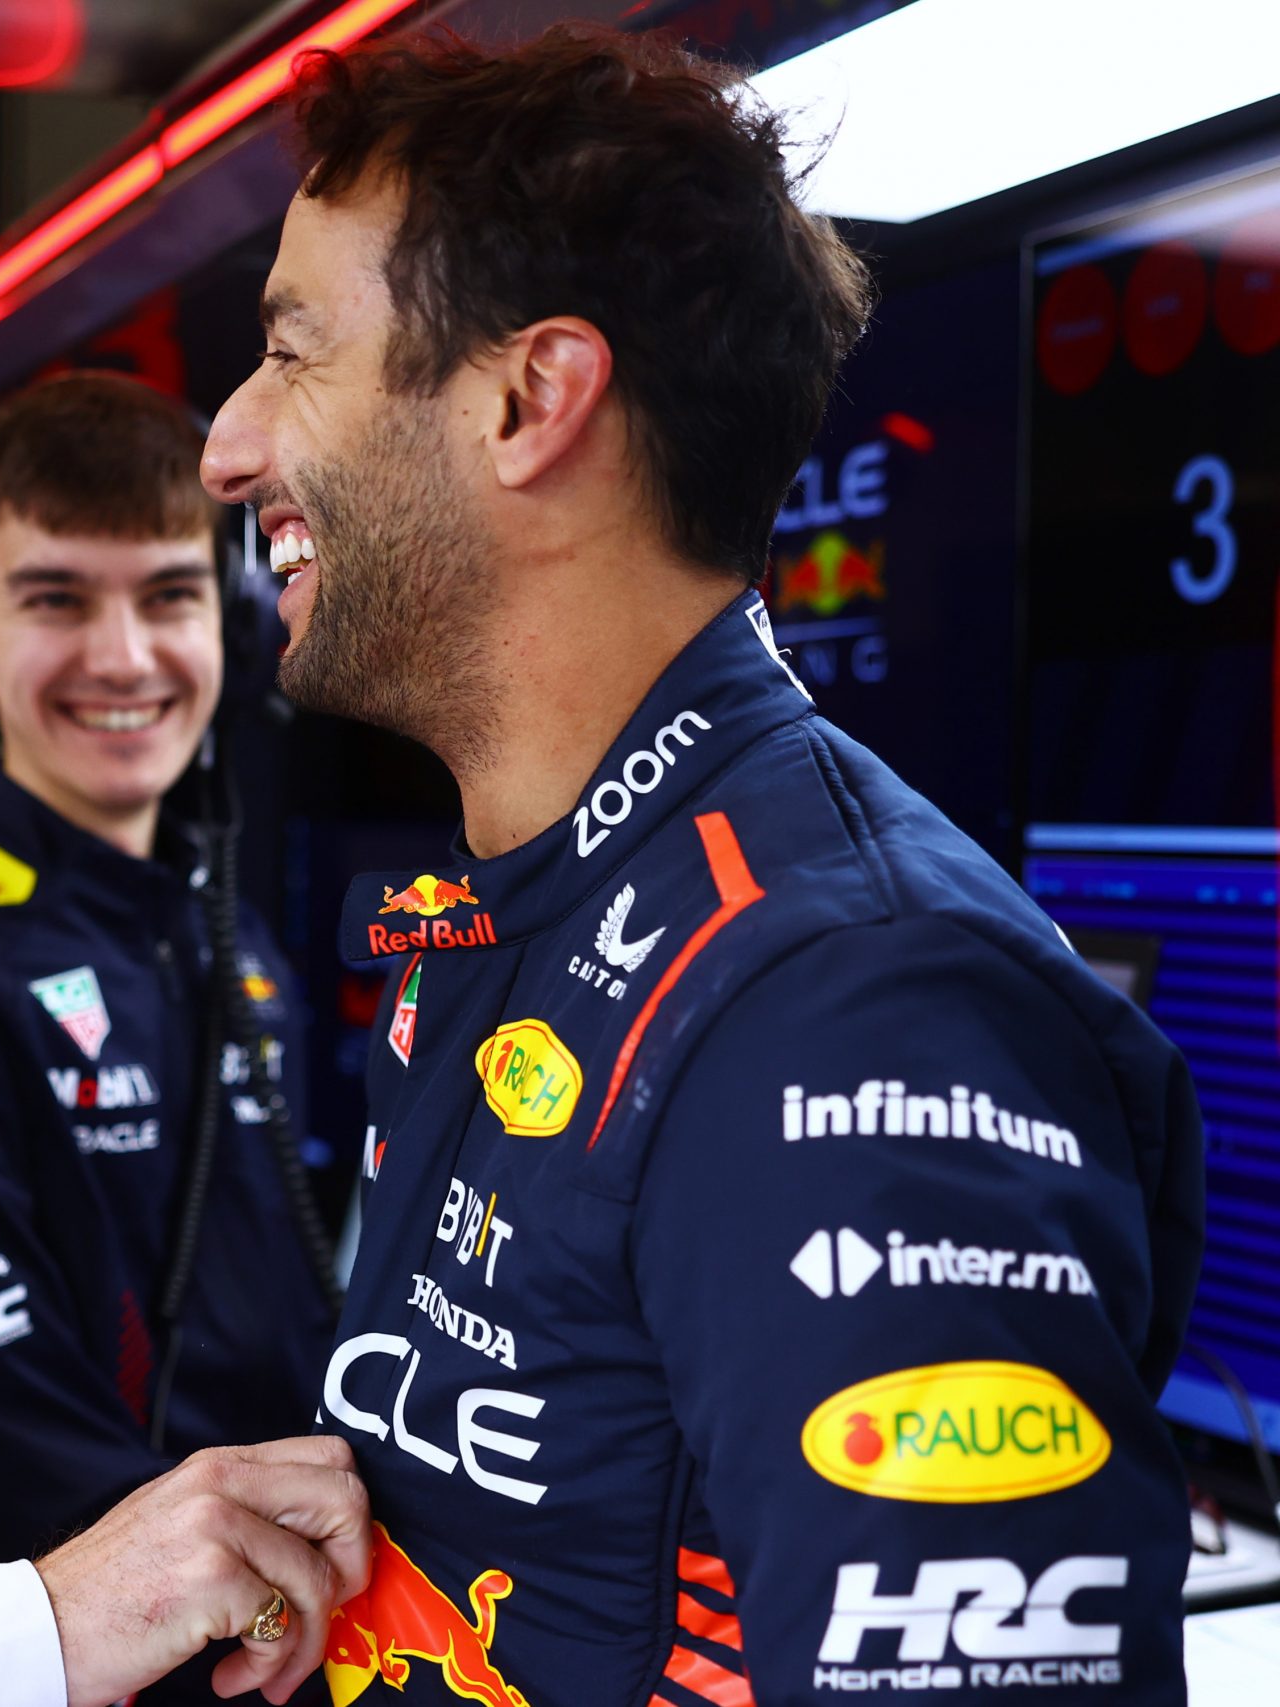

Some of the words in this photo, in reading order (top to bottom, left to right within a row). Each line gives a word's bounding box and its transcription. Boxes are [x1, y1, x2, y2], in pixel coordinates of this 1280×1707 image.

[1169, 453, 1239, 604] 3
[572, 710, 712, 858] zoom
[368, 920, 427, 956] Red
[431, 912, 497, 949] Bull
[782, 1081, 1082, 1167] infinitum
[407, 1273, 517, 1370] HONDA
[315, 1332, 548, 1505] CLE
[893, 1405, 1083, 1460] RAUCH
[818, 1555, 1129, 1664] HRC
[814, 1662, 963, 1691] Honda
[971, 1660, 1123, 1687] RACING
